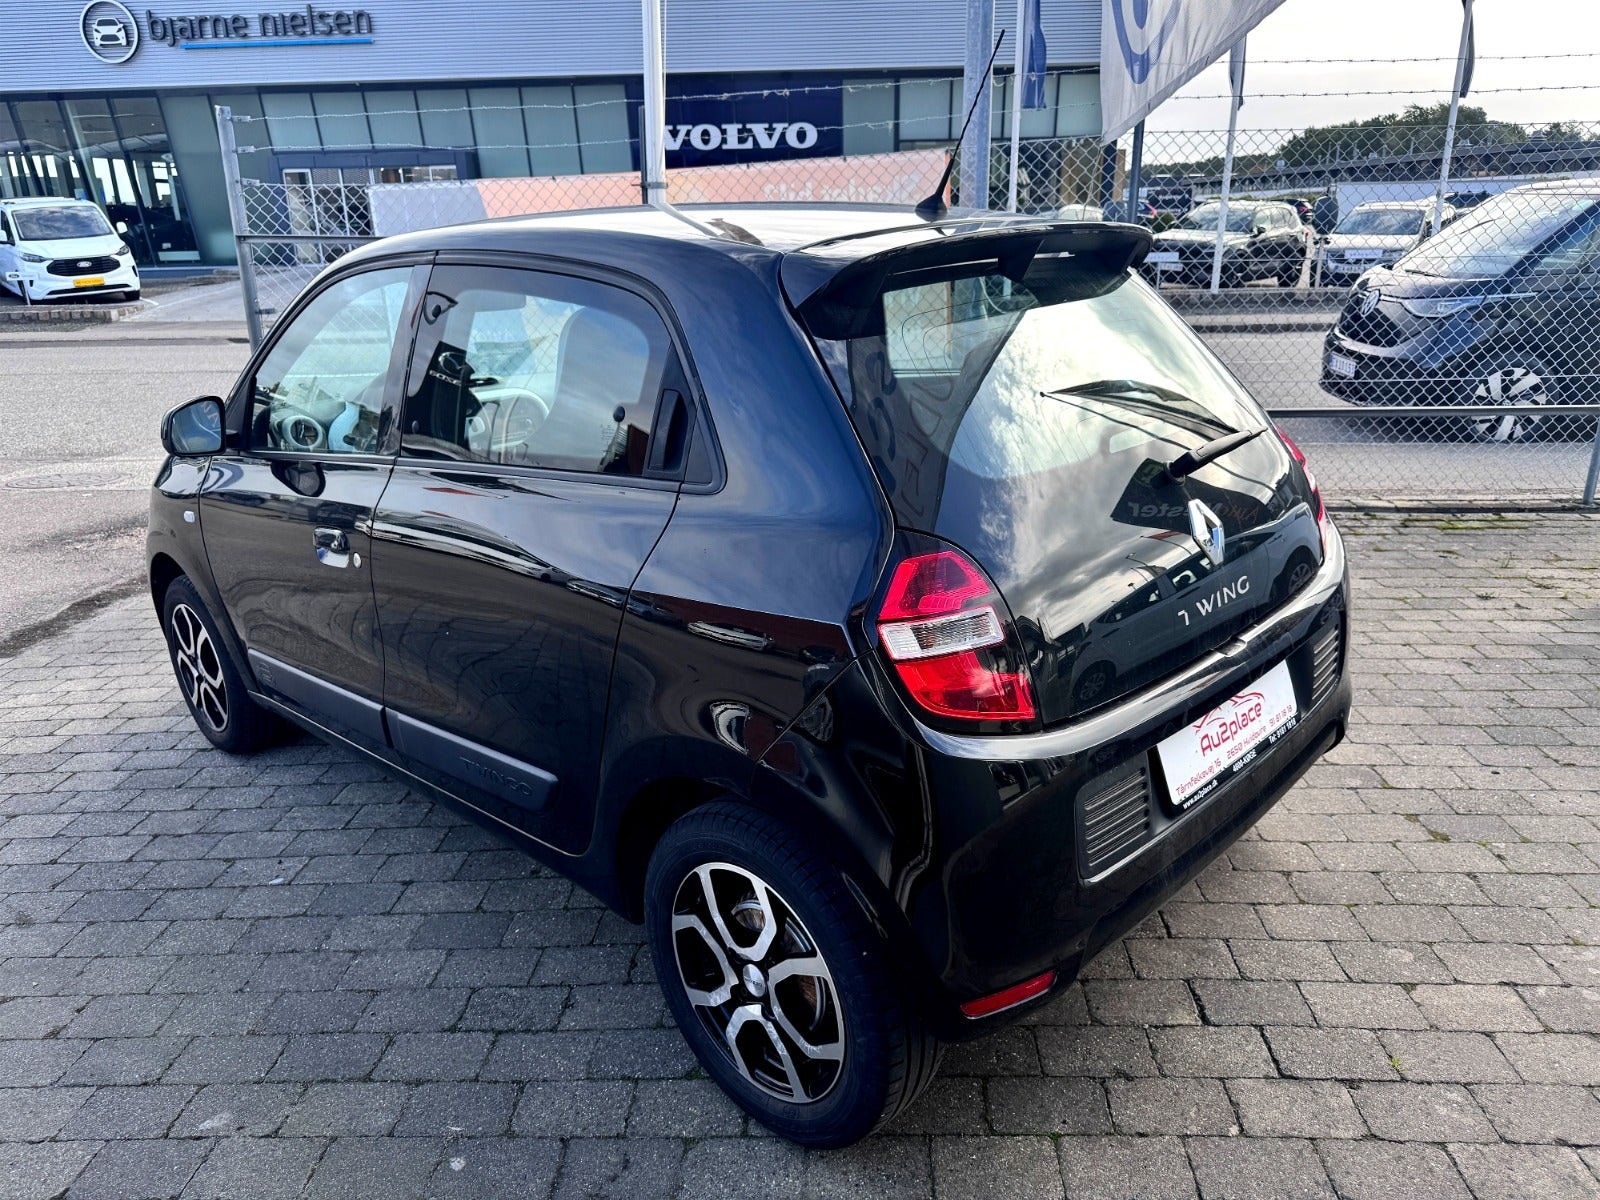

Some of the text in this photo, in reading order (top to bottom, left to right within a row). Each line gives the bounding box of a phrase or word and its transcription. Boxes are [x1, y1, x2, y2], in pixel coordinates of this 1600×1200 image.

[146, 3, 372, 47] bjarne nielsen
[664, 122, 818, 150] VOLVO
[1200, 702, 1262, 757] Au2place
[1226, 741, 1243, 759] 2650
[459, 756, 533, 796] TWINGO
